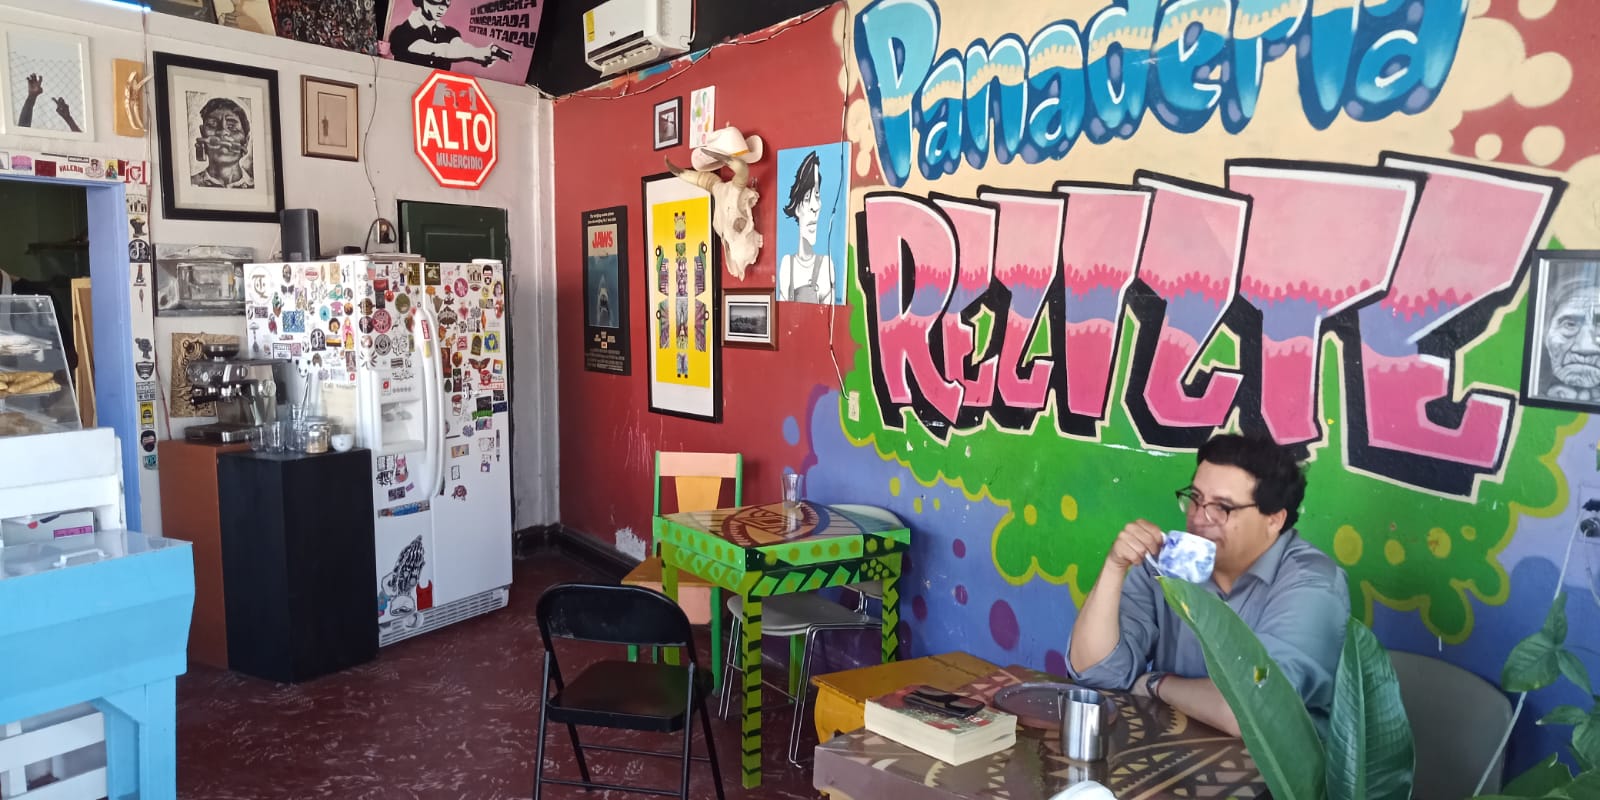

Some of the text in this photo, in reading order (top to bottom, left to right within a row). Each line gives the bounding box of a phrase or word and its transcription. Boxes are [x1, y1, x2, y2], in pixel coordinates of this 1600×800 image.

[422, 107, 491, 153] ALTO
[436, 152, 483, 170] MUJERCIDIO
[592, 230, 614, 249] JAWS
